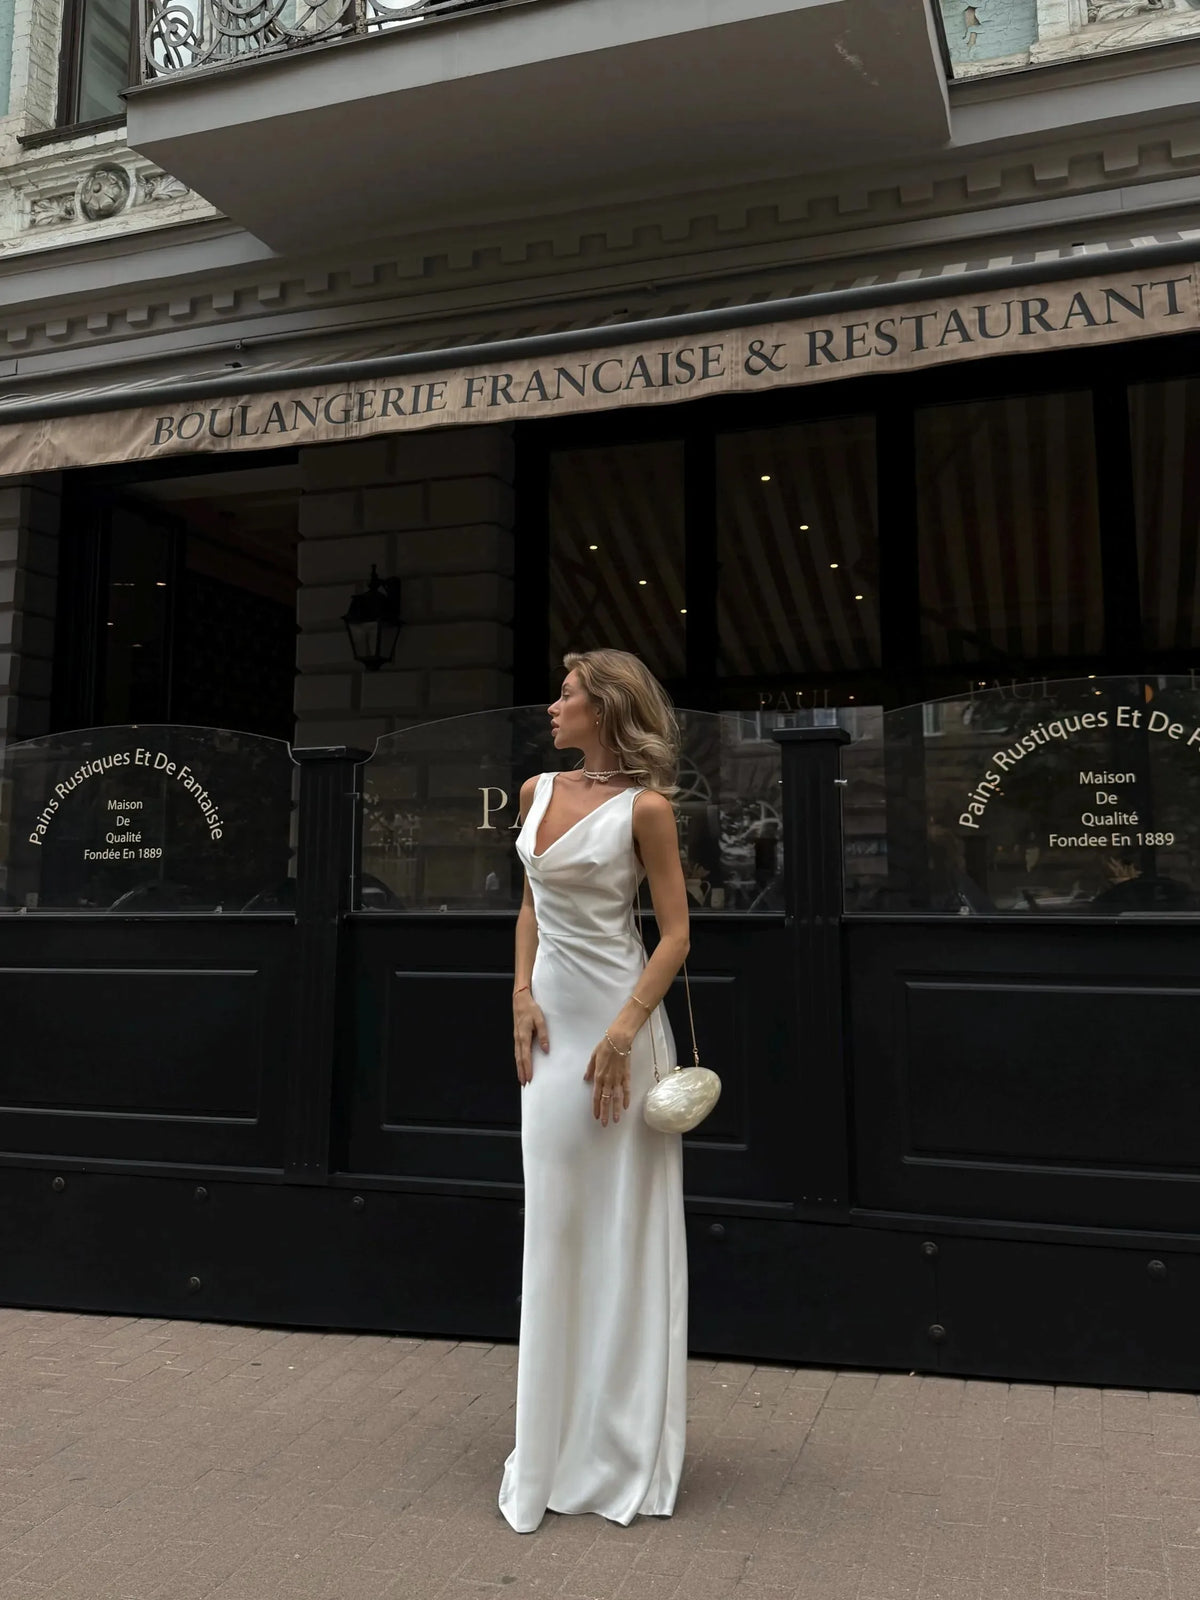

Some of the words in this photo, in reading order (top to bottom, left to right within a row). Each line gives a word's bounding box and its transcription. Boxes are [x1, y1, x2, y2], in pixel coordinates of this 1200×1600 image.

[150, 381, 448, 446] BOULANGERIE
[461, 343, 727, 408] FRANCAISE
[744, 339, 788, 375] &
[804, 274, 1192, 367] RESTAURANT
[958, 770, 1001, 829] Pains
[992, 710, 1109, 772] Rustiques
[1116, 706, 1143, 729] Et
[1147, 710, 1184, 740] De
[1079, 771, 1136, 785] Maison
[28, 799, 59, 846] Pains
[54, 751, 131, 800] Rustiques
[134, 748, 153, 767] Et
[153, 752, 177, 776] De
[176, 766, 224, 841] Fantaisie
[1096, 792, 1118, 806] De
[107, 799, 144, 811] Maison
[116, 816, 131, 827] De
[1081, 811, 1139, 828] Qualité
[105, 832, 142, 845] Qualité
[1111, 833, 1131, 847] En
[1135, 832, 1175, 847] 1889
[84, 848, 121, 860] Fondée
[122, 848, 135, 859] En
[138, 847, 163, 860] 1889
